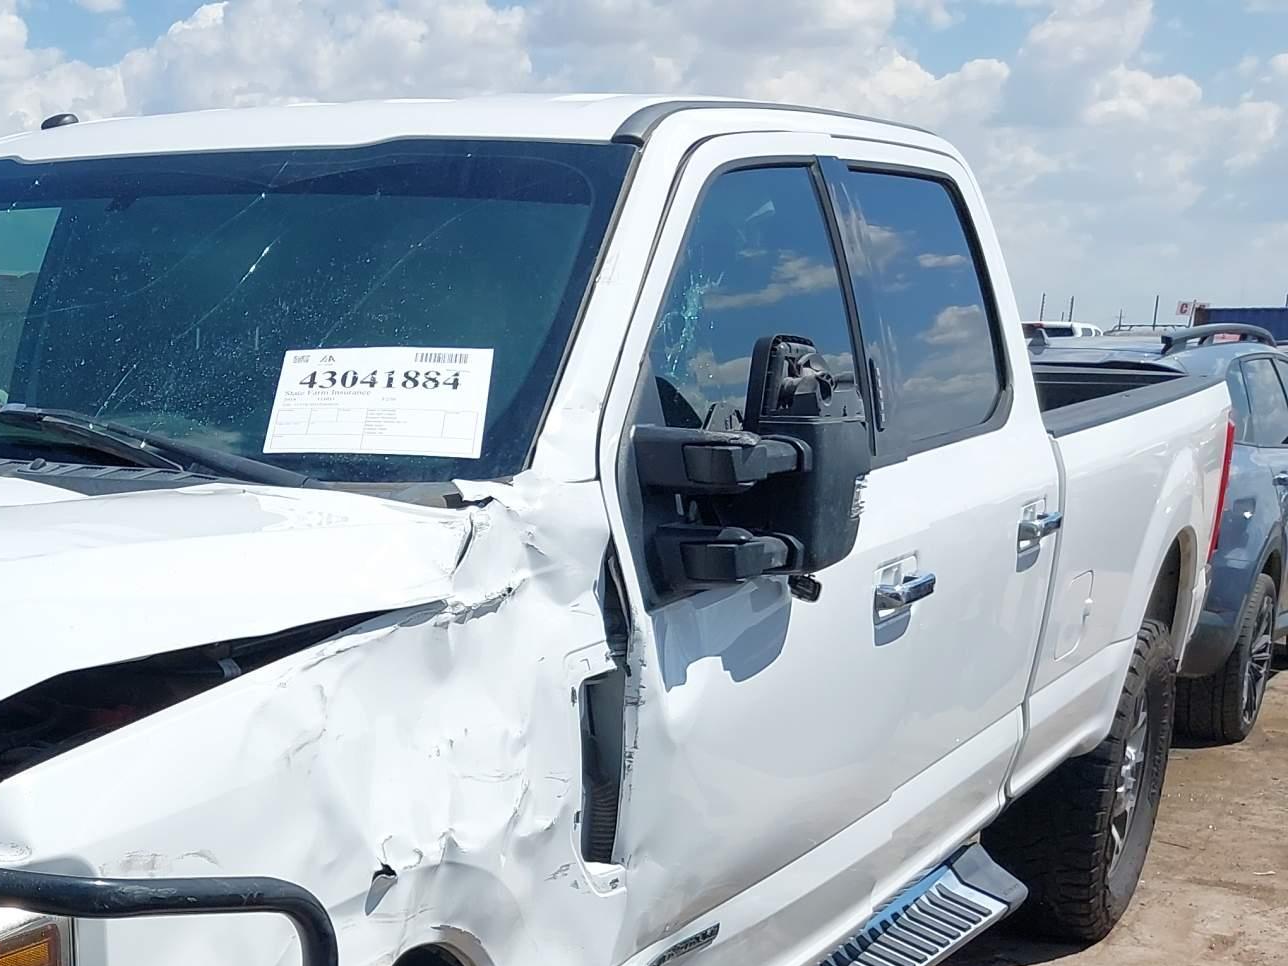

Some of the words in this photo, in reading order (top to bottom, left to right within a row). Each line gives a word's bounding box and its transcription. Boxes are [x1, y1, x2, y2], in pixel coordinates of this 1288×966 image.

[298, 369, 462, 390] 43041884
[307, 389, 330, 397] Farm
[331, 389, 372, 397] Insurance
